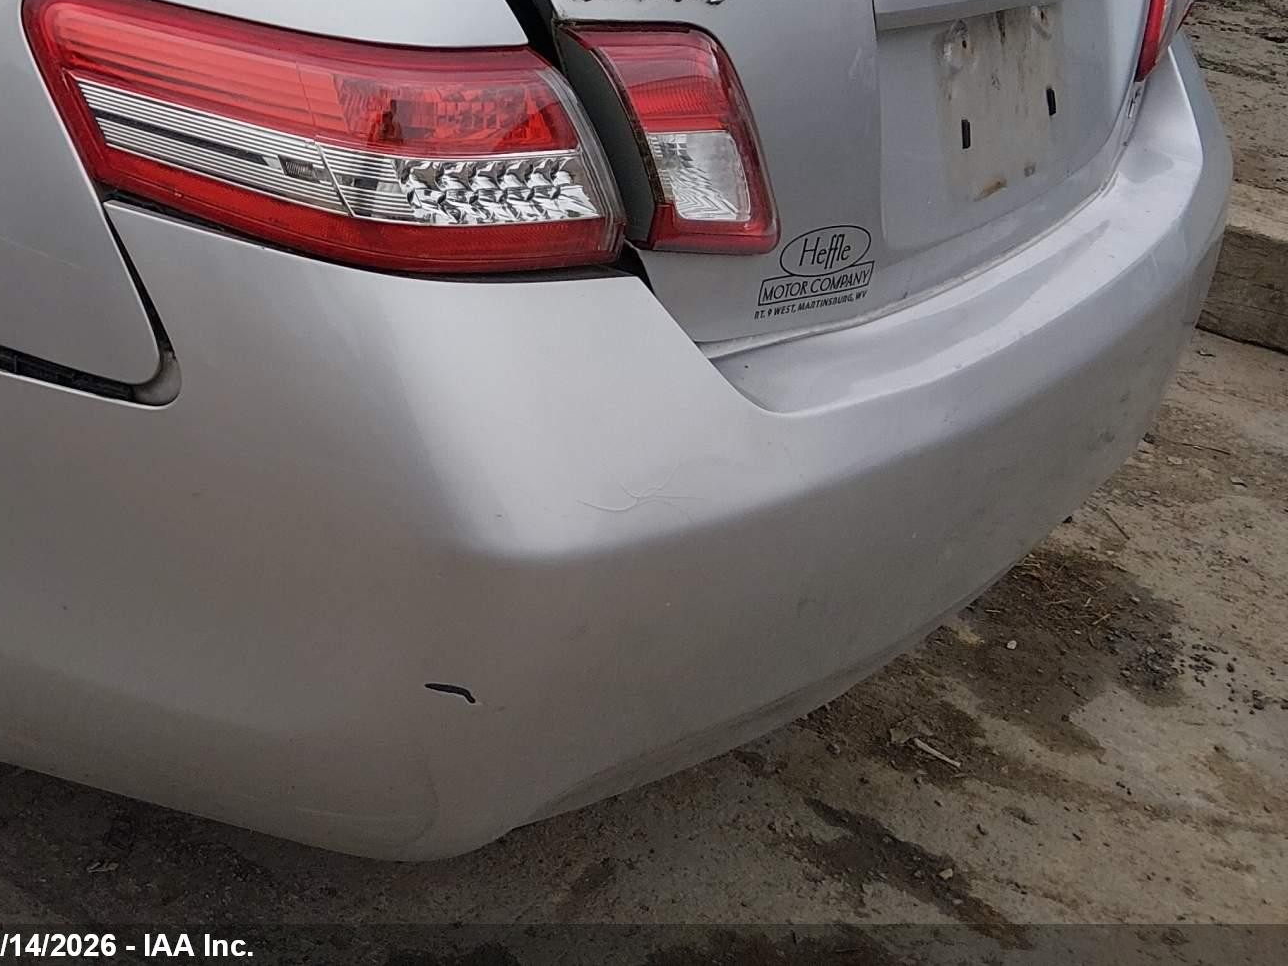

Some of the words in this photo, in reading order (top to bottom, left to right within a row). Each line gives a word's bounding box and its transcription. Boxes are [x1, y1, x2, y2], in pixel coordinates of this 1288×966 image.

[799, 234, 851, 270] Heffle
[762, 281, 809, 303] MOTOR
[810, 270, 870, 294] COMPANY
[767, 308, 773, 317] 9
[855, 290, 868, 300] WV
